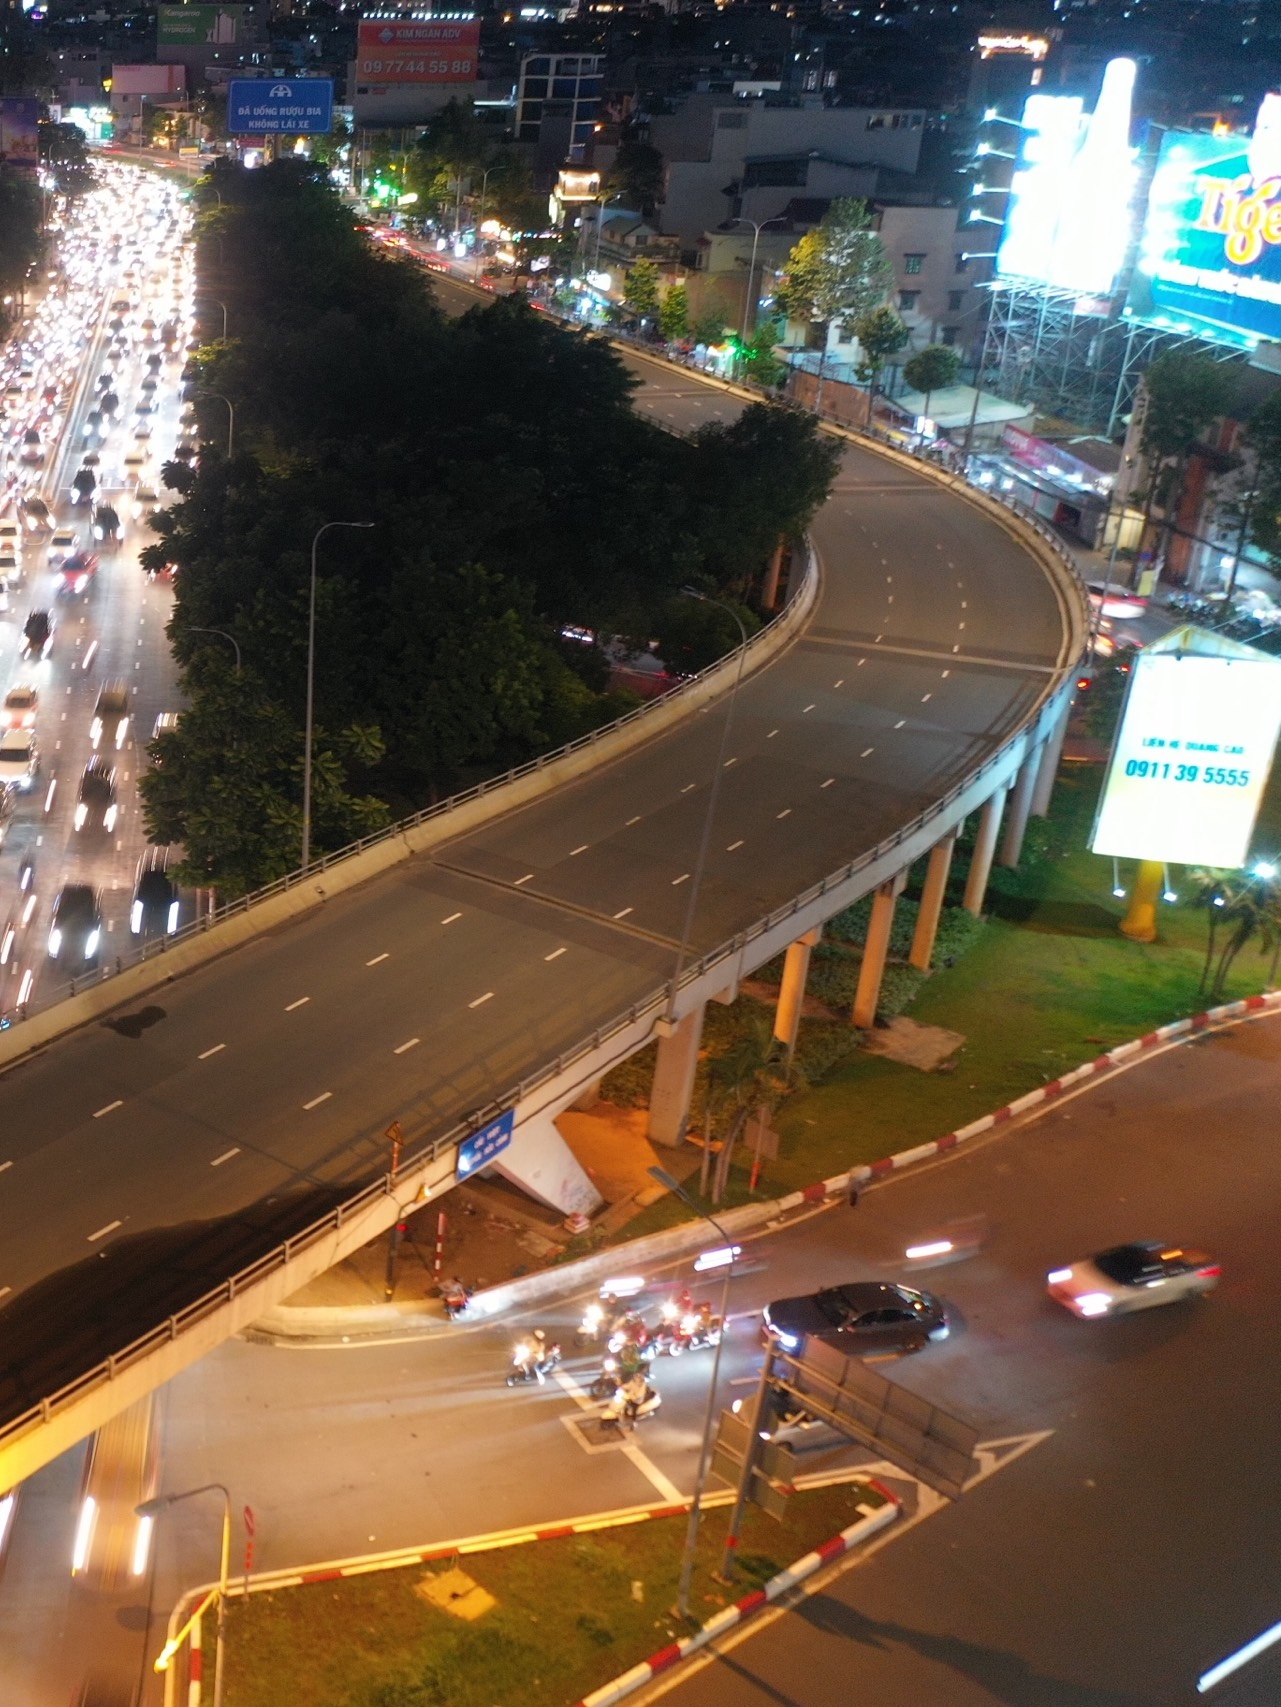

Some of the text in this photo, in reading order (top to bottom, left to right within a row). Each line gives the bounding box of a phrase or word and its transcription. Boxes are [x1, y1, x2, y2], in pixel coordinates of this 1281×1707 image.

[164, 9, 200, 17] Kangaroo
[396, 30, 413, 38] KIM
[442, 30, 461, 38] ADV
[238, 104, 322, 117] ĐÃ UỐNG RƯỢU BIA
[248, 119, 310, 129] KHÔNG LÁI XE
[1125, 759, 1251, 787] 0911 39 5555
